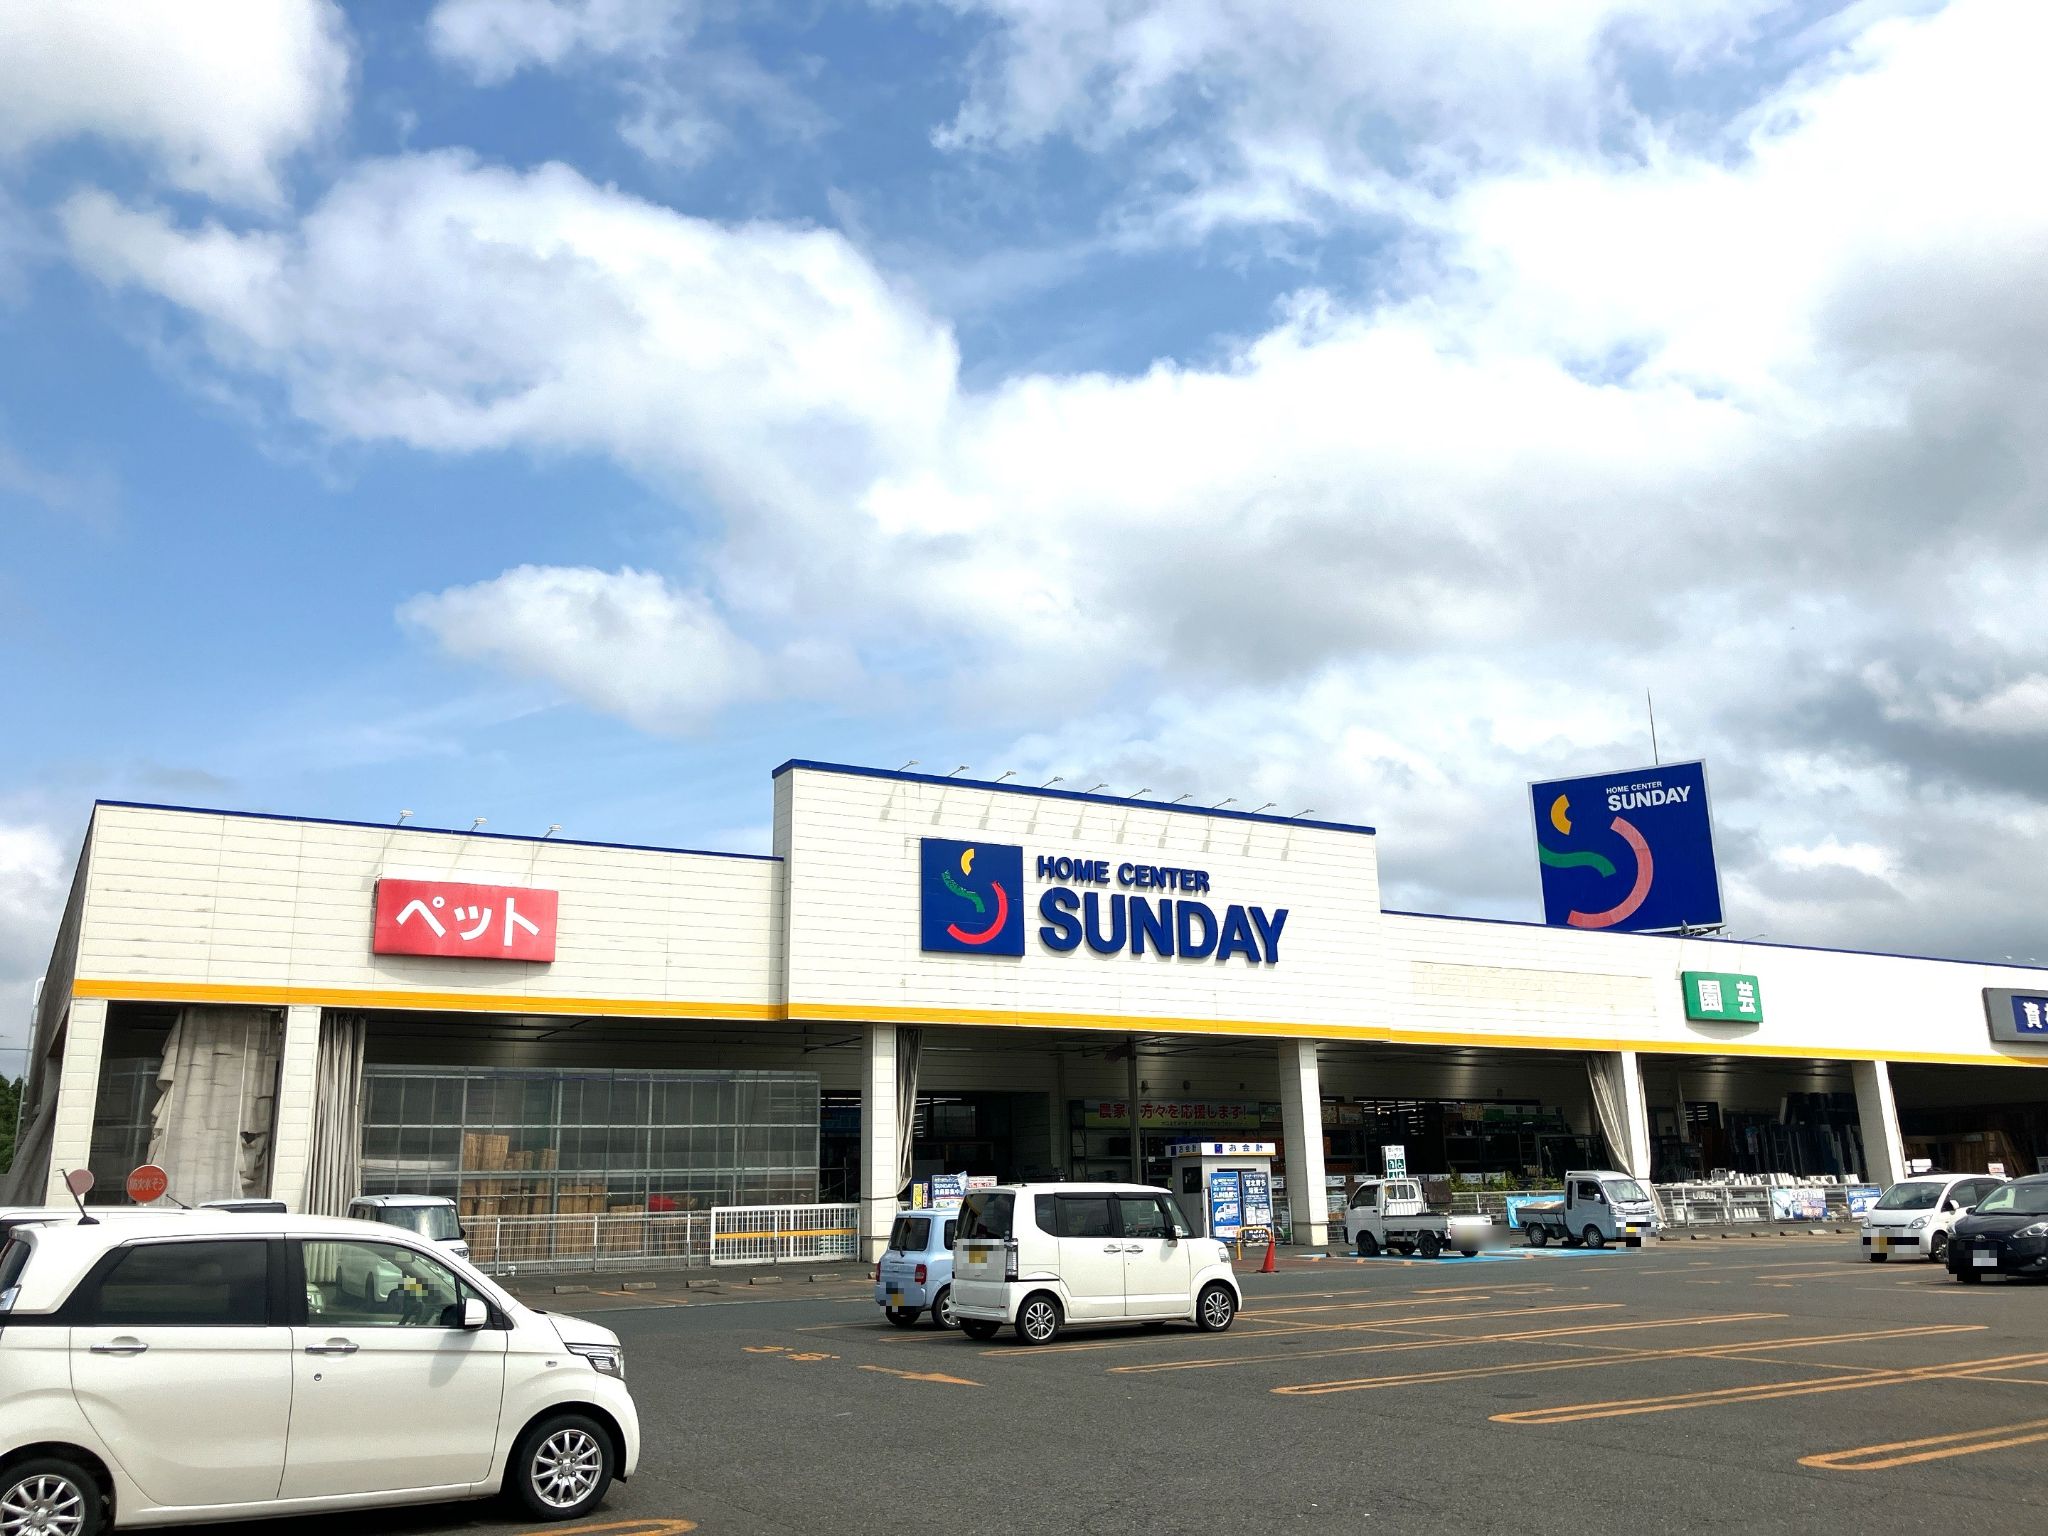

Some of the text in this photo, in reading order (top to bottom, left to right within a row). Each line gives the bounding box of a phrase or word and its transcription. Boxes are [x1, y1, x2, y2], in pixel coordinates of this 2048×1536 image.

[1606, 781, 1662, 794] HOME CENTER
[1608, 785, 1691, 812] SUNDAY
[1037, 855, 1210, 892] HOME CENTER
[395, 896, 541, 947] ペット
[1039, 887, 1290, 963] SUNDAY
[1697, 979, 1757, 1014] 園芸
[2022, 1001, 2048, 1029] 資
[1098, 1103, 1247, 1120] 農家方々を応援します!
[1228, 1143, 1264, 1152] お会計
